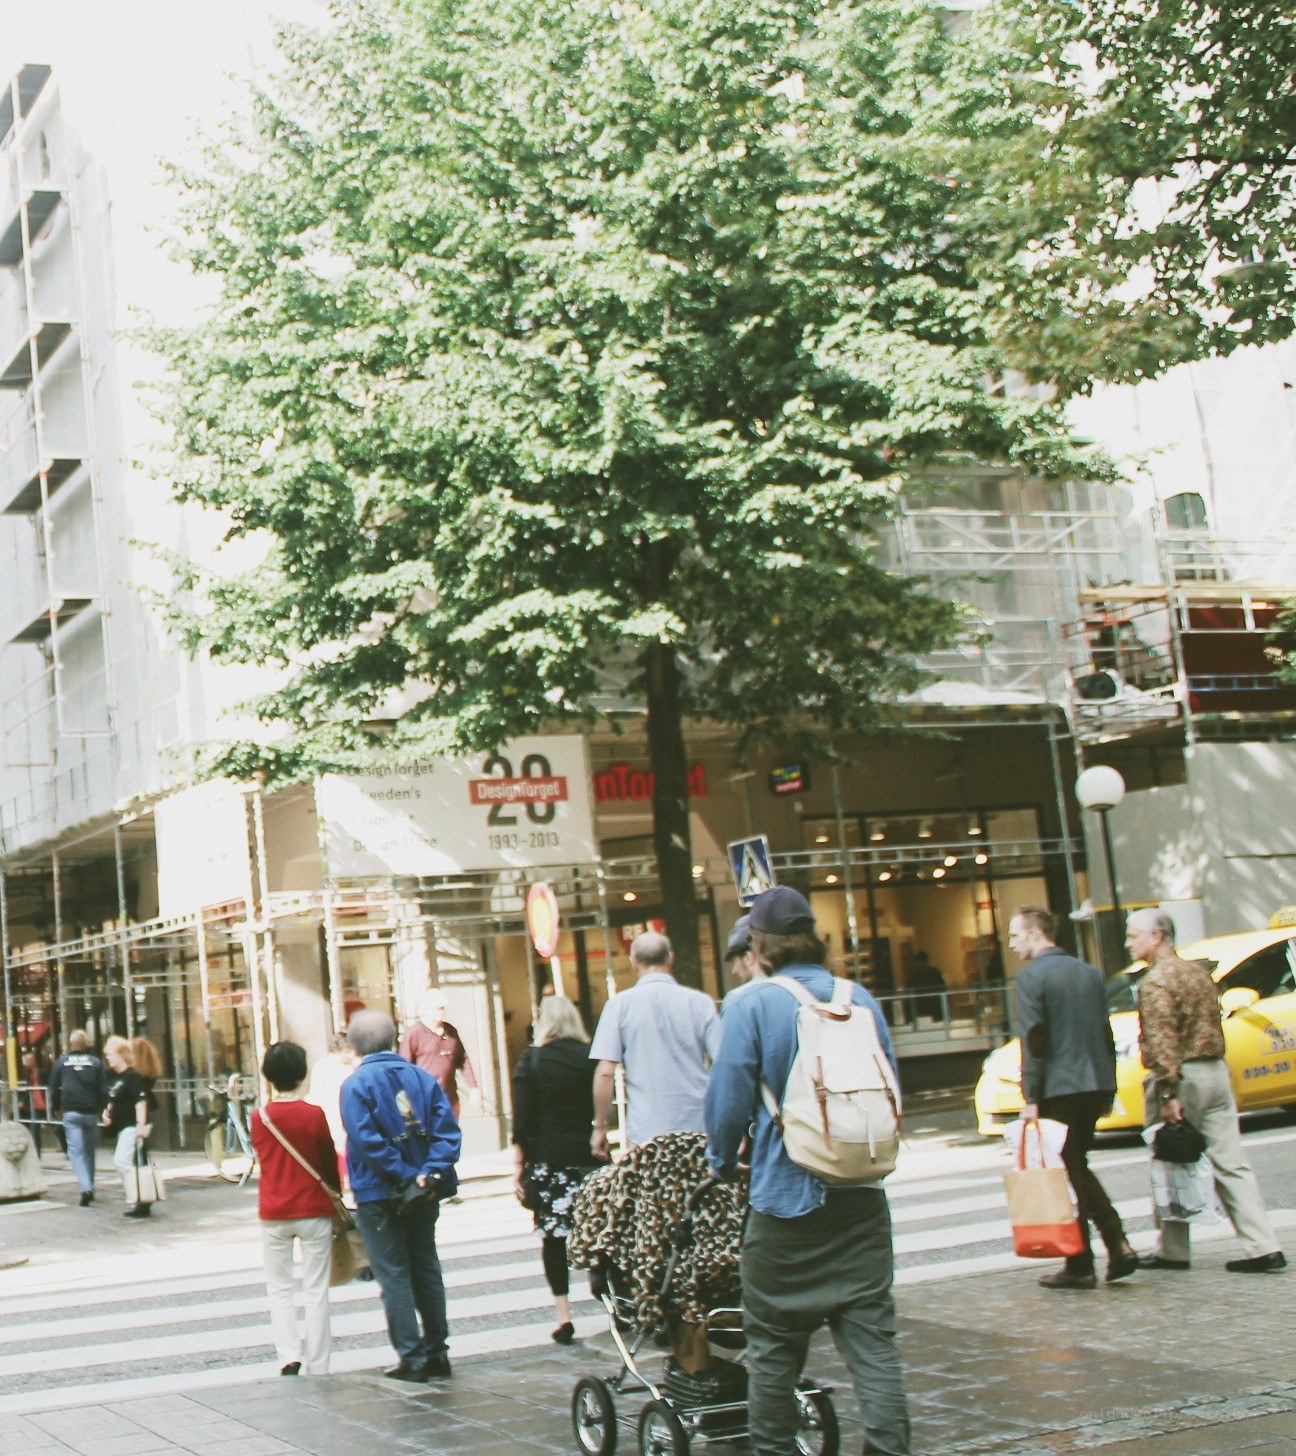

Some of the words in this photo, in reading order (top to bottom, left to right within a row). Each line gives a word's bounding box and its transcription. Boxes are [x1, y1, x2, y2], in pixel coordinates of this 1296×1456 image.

[360, 786, 421, 800] weden's
[477, 780, 561, 801] DesignTorget
[483, 754, 556, 827] 20
